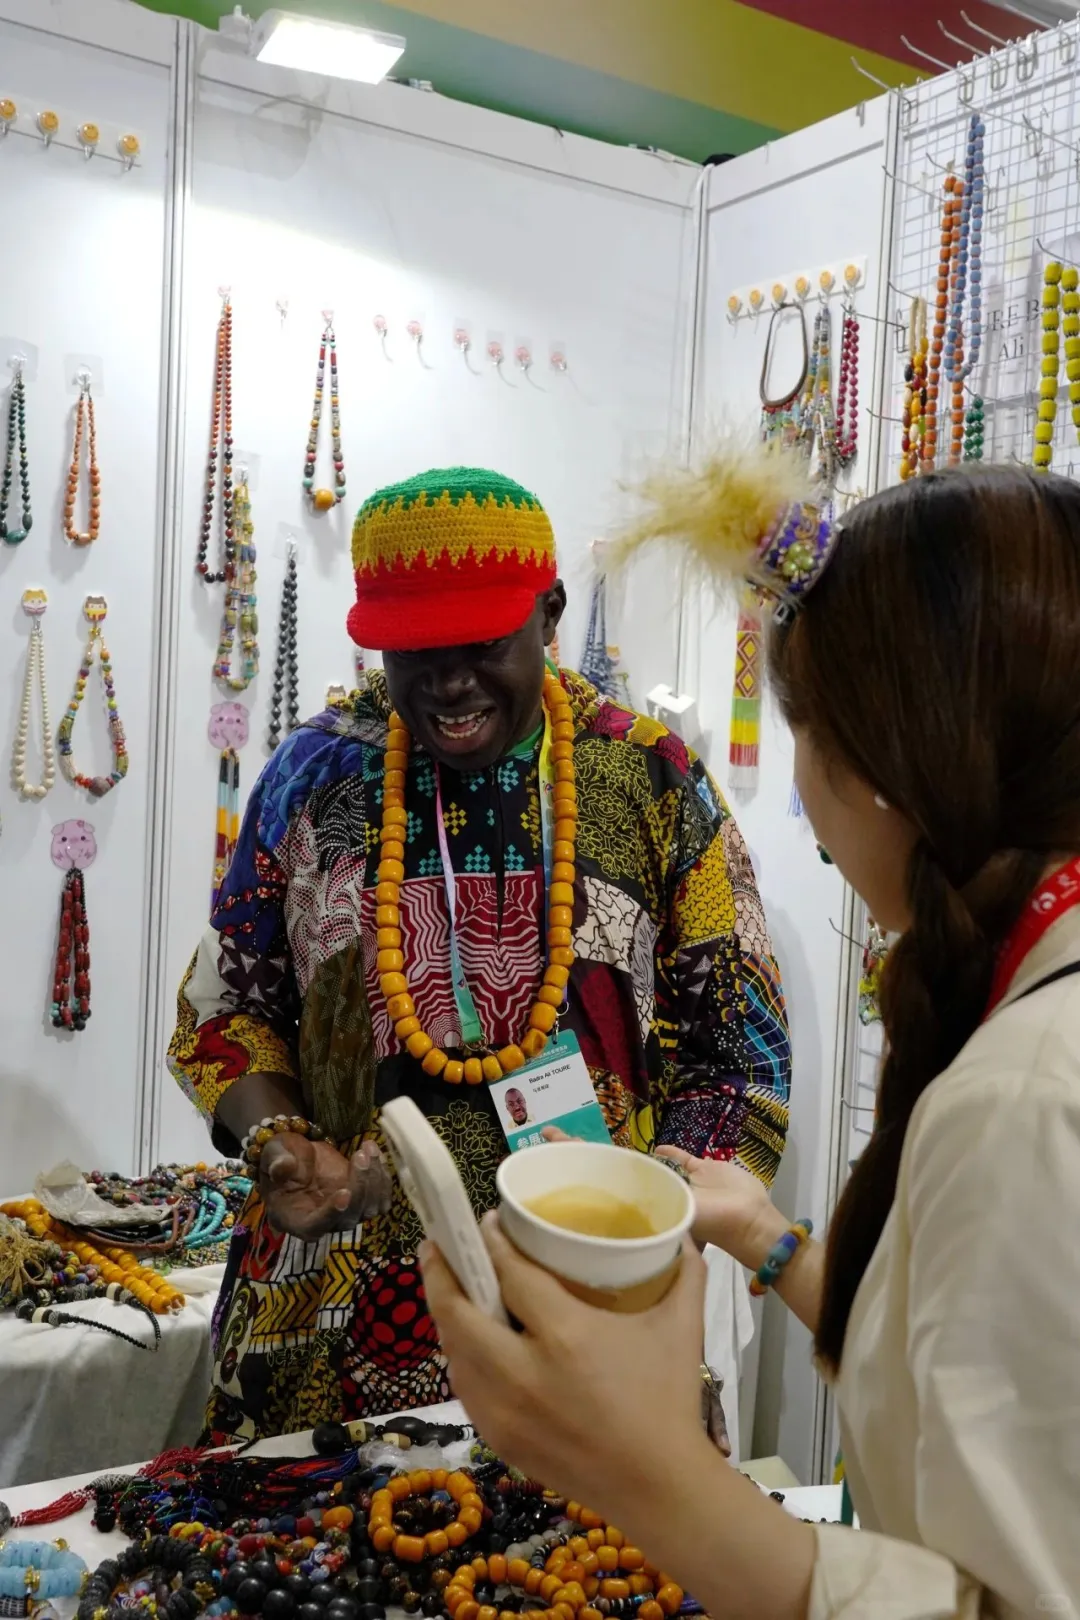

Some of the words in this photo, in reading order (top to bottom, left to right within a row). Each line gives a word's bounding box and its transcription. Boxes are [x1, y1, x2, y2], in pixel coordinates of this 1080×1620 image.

[999, 336, 1024, 359] Ali
[551, 1064, 571, 1075] TOURE
[517, 1132, 547, 1149] 参展
